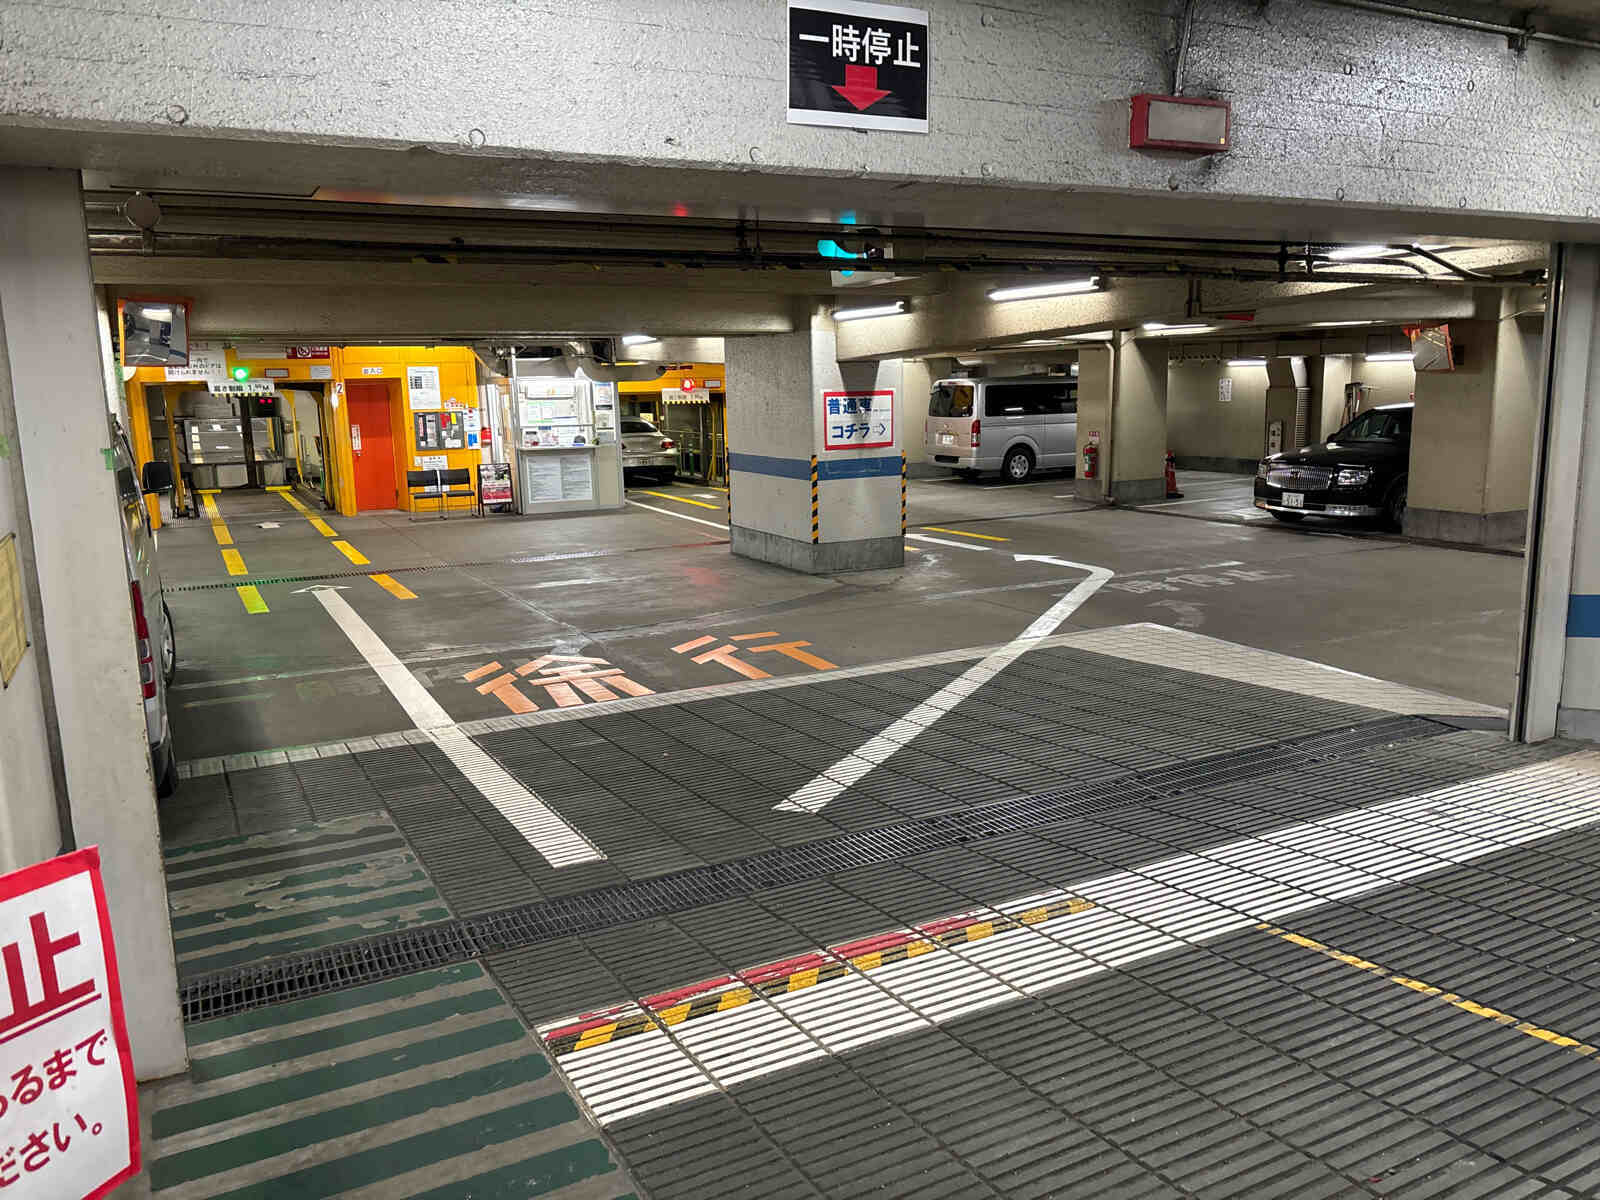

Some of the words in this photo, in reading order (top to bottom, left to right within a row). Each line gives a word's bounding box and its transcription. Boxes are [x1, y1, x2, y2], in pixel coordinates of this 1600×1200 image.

[798, 24, 921, 68] 一時停止
[336, 383, 343, 394] 2
[828, 397, 872, 416] 普通車
[832, 423, 870, 440] コチラ
[464, 631, 839, 715] 徐行
[0, 912, 96, 1033] 止
